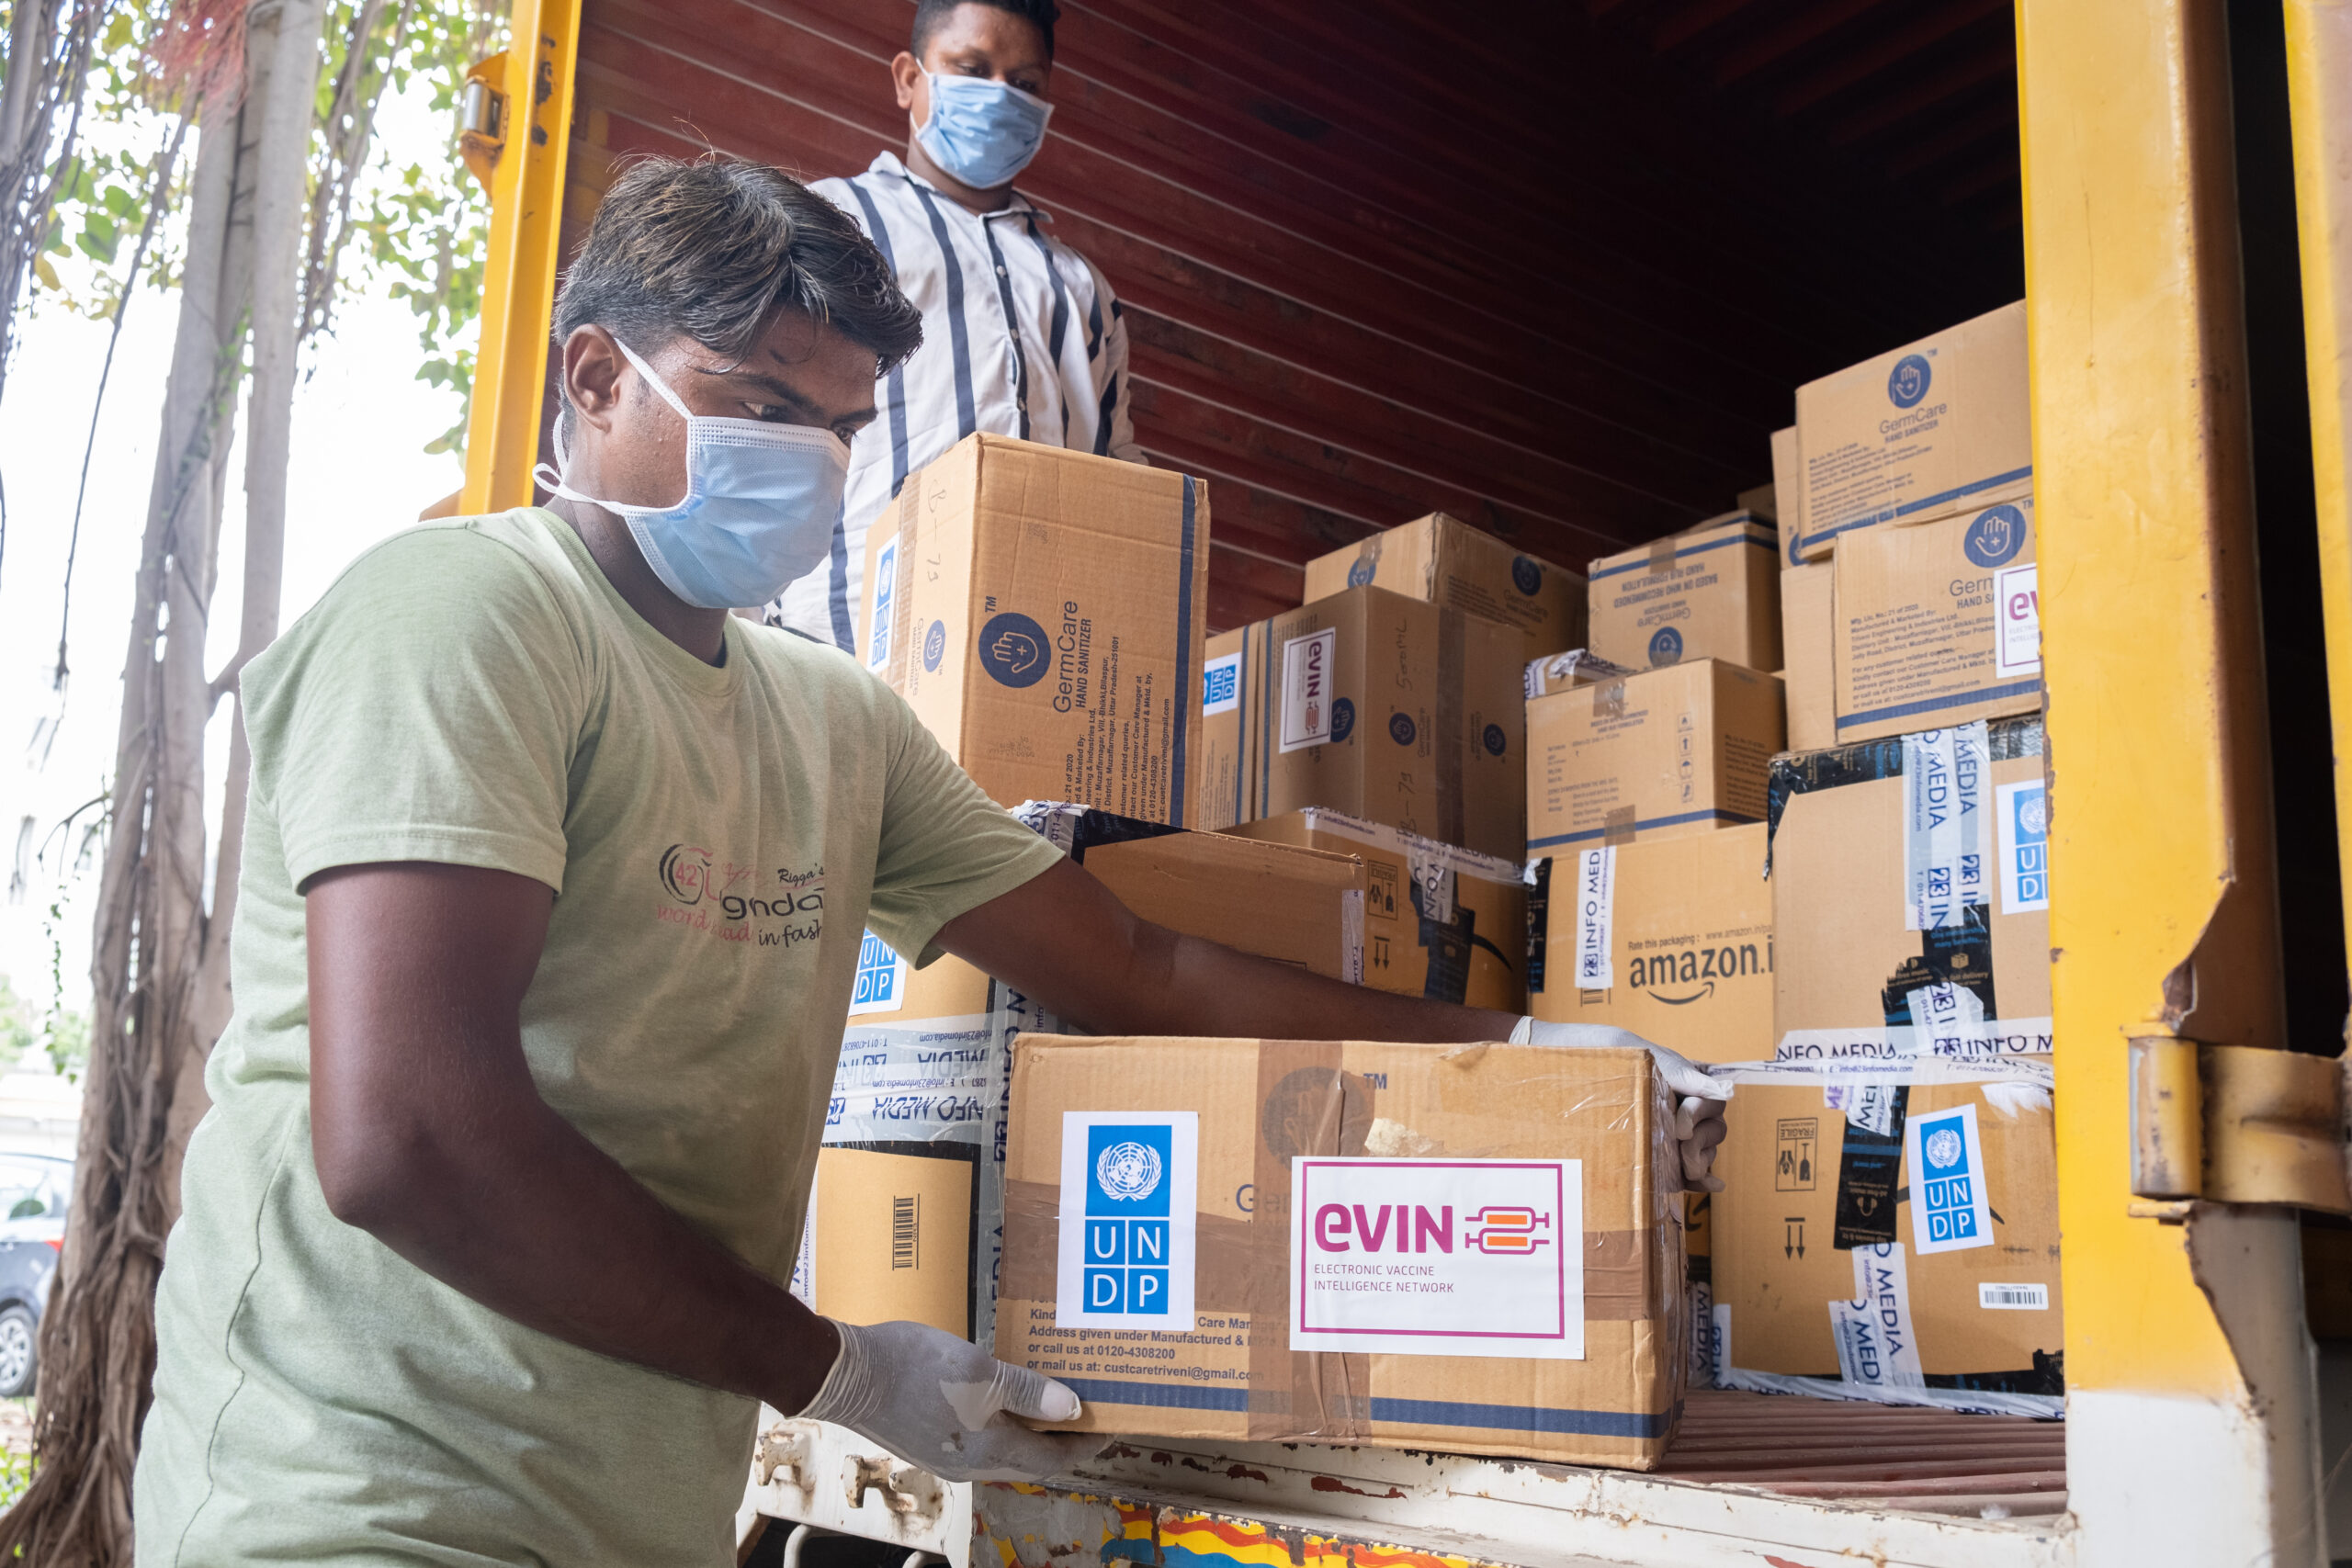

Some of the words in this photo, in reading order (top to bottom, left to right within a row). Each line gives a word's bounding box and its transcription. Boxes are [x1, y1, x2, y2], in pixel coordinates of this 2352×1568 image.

[1880, 403, 1948, 434] GermCare
[985, 596, 996, 613] TM
[1637, 607, 1690, 627] GermCare
[1957, 596, 1982, 609] HAND
[913, 617, 924, 696] GermCare
[1053, 601, 1079, 713] GermCare
[1077, 619, 1091, 674] SANITIZER
[1108, 636, 1119, 694] Pradesh-251001
[1307, 641, 1322, 698] eVIN
[1075, 678, 1088, 707] HAND
[1108, 697, 1116, 716] Uttar
[1134, 685, 1143, 719] Manager
[1088, 708, 1096, 723] Ltd.
[1077, 734, 1086, 748] By:
[1086, 726, 1095, 764] Industries
[1121, 720, 1130, 751] queries,
[1132, 722, 1140, 739] Care
[1141, 718, 1150, 772] Manufactured
[1104, 718, 1116, 773] Muzaffarnagar,
[1131, 741, 1139, 779] Customer
[1159, 698, 1170, 805] custcaretriveni@gmail.com
[1076, 750, 1084, 784] Marketed
[1095, 735, 1105, 790] Muzaffarnagar,
[1120, 753, 1128, 781] related
[1066, 773, 1073, 783] of
[1066, 784, 1072, 793] 21
[1148, 755, 1159, 808] 0120-4308200
[1928, 752, 1947, 829] MEDIA
[1955, 739, 1977, 816] MEDIA
[1139, 797, 1148, 819] given
[1928, 867, 1951, 898] 23
[1586, 900, 1597, 949] INFO
[1628, 941, 1643, 951] Rate
[1645, 939, 1657, 948] this
[1659, 935, 1694, 950] packaging
[1584, 953, 1599, 977] 23
[873, 1078, 944, 1088] info@23infomedia.com
[1363, 1073, 1387, 1089] TM
[873, 1097, 937, 1119] MEDIA
[1781, 1128, 1815, 1139] FRAGILE
[1315, 1203, 1453, 1253] eVIN
[1314, 1264, 1382, 1275] ELECTRONIC
[1386, 1265, 1435, 1277] VACCINE
[1314, 1280, 1393, 1292] INTELLIGENCE
[1396, 1281, 1453, 1293] NETWORK
[1198, 1316, 1226, 1328] Care
[1876, 1269, 1904, 1359] MEDIA
[1029, 1325, 1077, 1337] Address
[1080, 1328, 1110, 1341] given
[1114, 1330, 1148, 1341] under
[1151, 1331, 1231, 1345] Manufactured
[1235, 1336, 1244, 1347] &
[1698, 1290, 1709, 1371] MEDIA
[1028, 1344, 1040, 1352] or
[1043, 1343, 1062, 1354] call
[1066, 1346, 1080, 1354] us
[1083, 1346, 1093, 1356] at
[1097, 1345, 1175, 1359] 0120-4308200
[1027, 1360, 1038, 1369] or
[1042, 1359, 1066, 1371] mail
[1069, 1363, 1082, 1371] us
[1086, 1362, 1101, 1372] at:
[1104, 1364, 1264, 1381] custcaretriveni@gmail.com
